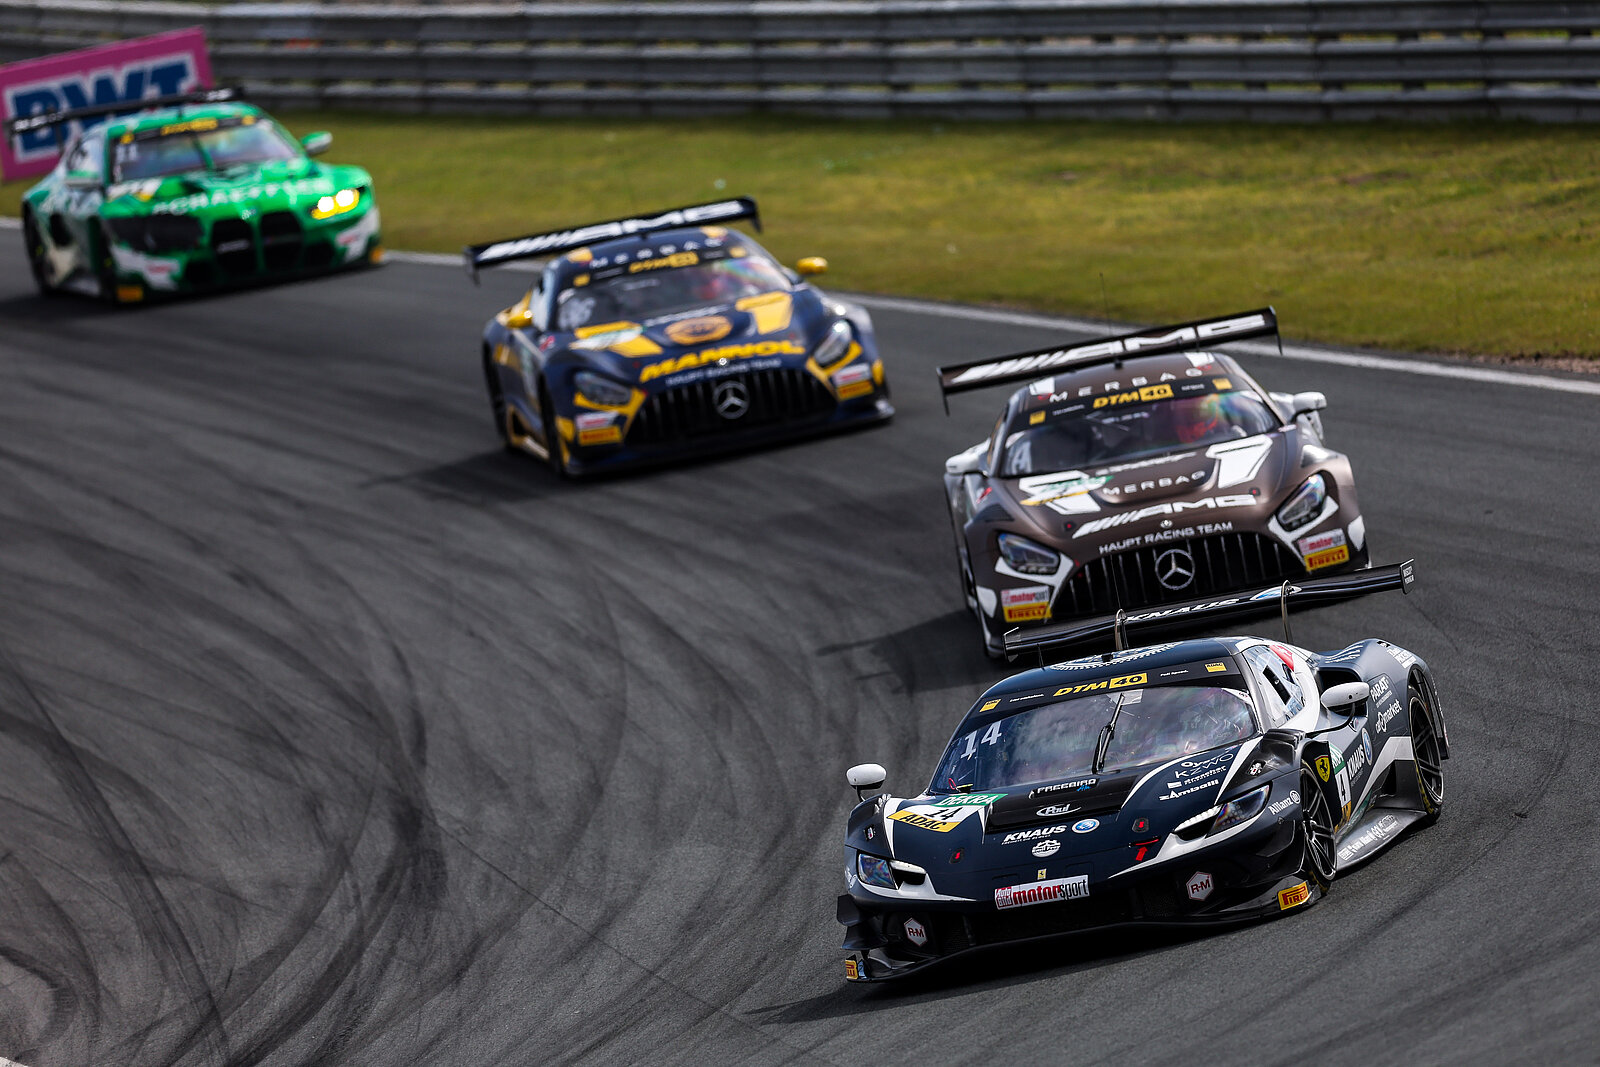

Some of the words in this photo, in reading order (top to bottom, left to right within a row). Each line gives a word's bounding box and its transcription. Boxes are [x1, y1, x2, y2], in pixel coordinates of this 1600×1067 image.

[12, 62, 190, 152] BWT
[640, 340, 805, 383] MANNOL
[1049, 368, 1203, 403] MERBAG
[1093, 391, 1139, 408] DTM
[1143, 387, 1168, 398] 40
[1102, 470, 1205, 495] MERBAG
[1099, 536, 1142, 554] HAUPT
[1144, 526, 1195, 544] RACING
[1197, 520, 1233, 534] TEAM
[1126, 598, 1240, 622] KNAUS
[1053, 681, 1108, 697] DTM
[1113, 675, 1144, 687] 40
[1370, 676, 1389, 702] PARAT
[960, 720, 1002, 761] 14
[1174, 753, 1234, 779] KZWO
[1346, 743, 1365, 781] KNAUS
[1037, 778, 1097, 794] FREEBIRD
[940, 794, 999, 805] DEKRA
[1268, 796, 1293, 815] Allianz
[899, 813, 948, 830] ADAC
[923, 807, 963, 820] 14
[1003, 825, 1067, 842] KNAUS
[1013, 879, 1088, 905] motorsport
[1190, 878, 1212, 894] R-M
[907, 926, 925, 938] R-M
